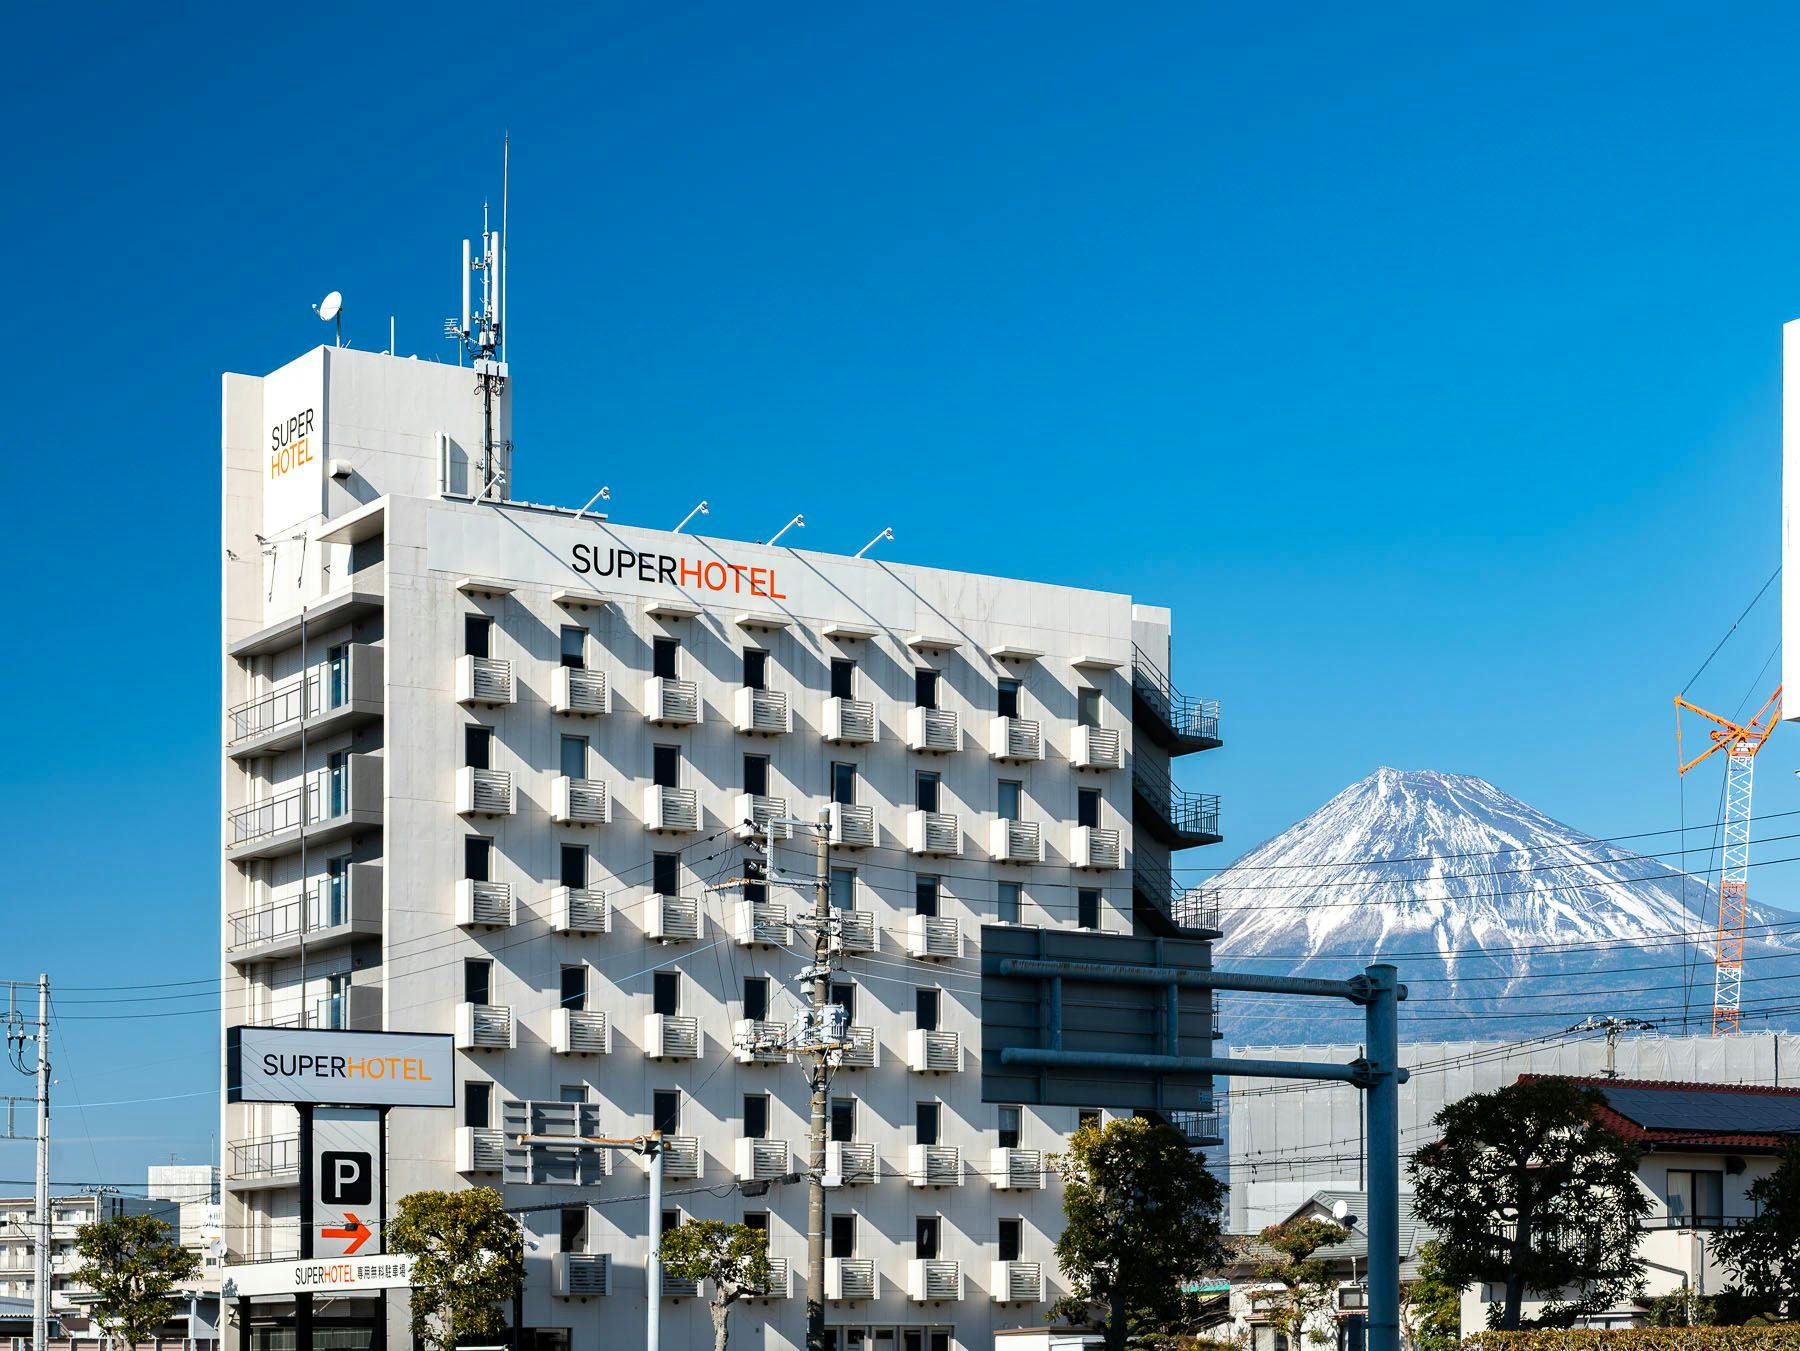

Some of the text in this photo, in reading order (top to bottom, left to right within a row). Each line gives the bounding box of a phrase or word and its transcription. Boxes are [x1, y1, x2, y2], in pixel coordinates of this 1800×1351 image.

[272, 408, 314, 451] SUPER
[272, 437, 313, 480] HOTEL
[571, 543, 787, 600] SUPERHOTEL
[263, 1053, 432, 1081] SUPERHOTEL
[335, 1159, 360, 1198] P
[295, 1264, 355, 1285] SUPERHOTEL
